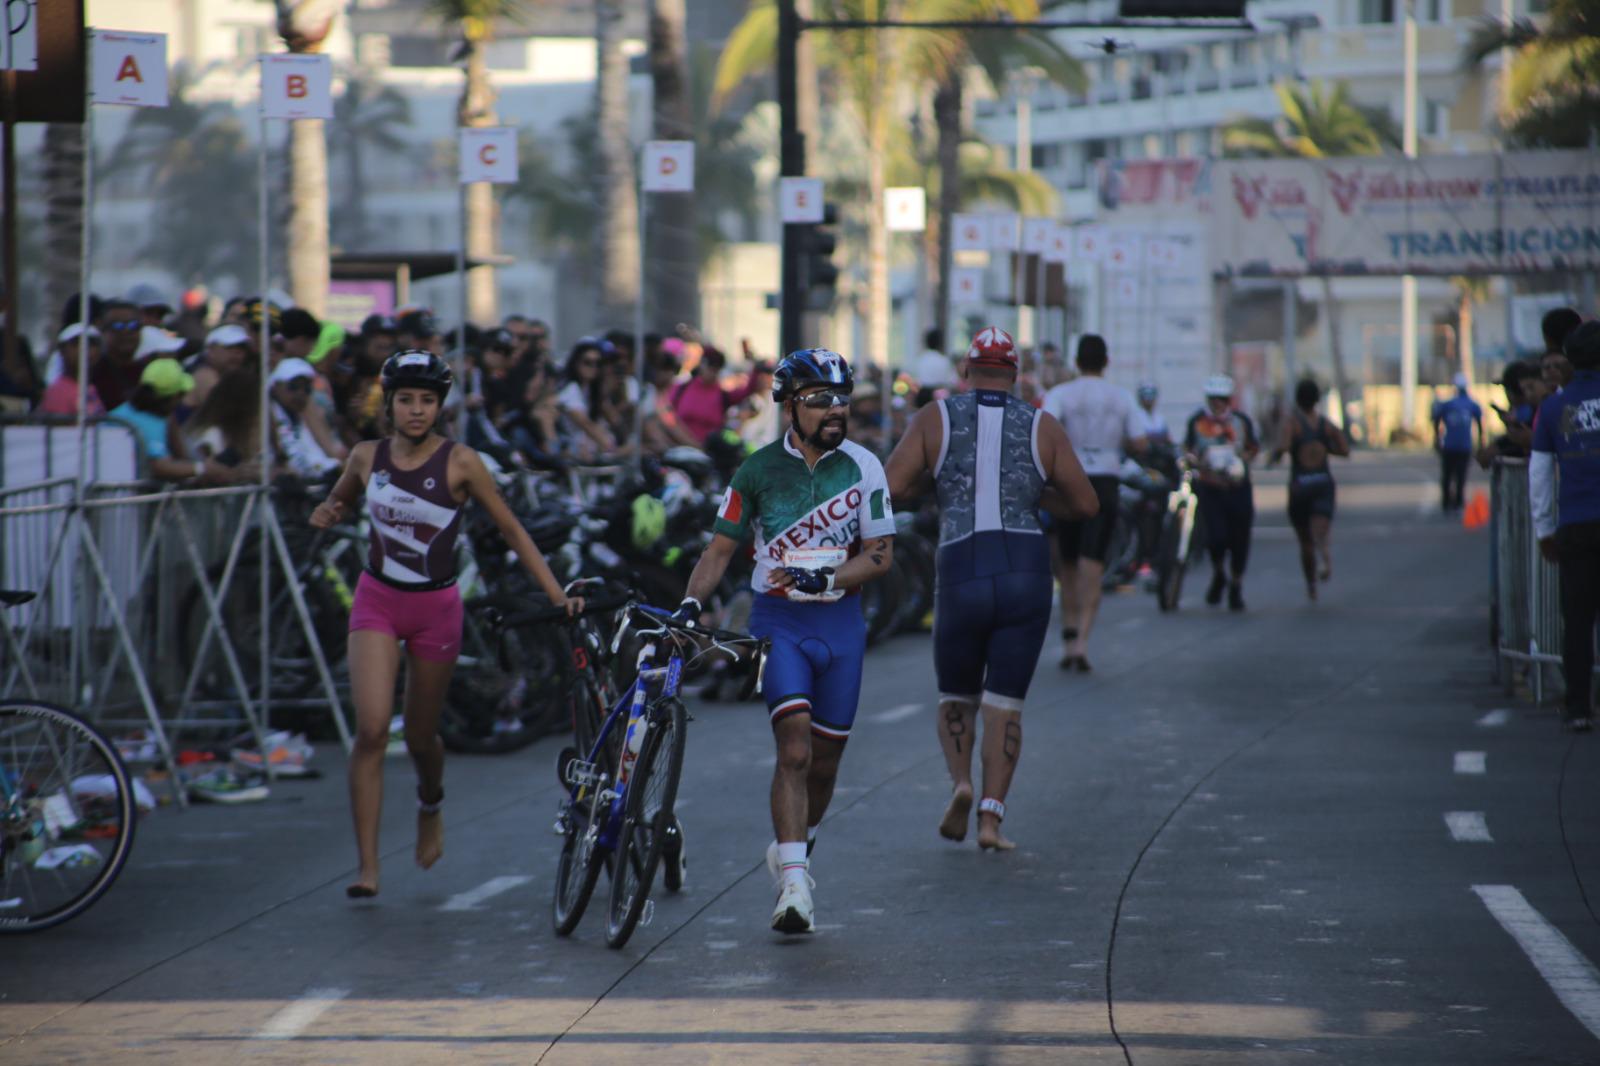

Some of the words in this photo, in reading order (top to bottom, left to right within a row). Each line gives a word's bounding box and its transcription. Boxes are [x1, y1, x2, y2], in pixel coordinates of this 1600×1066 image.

[115, 54, 144, 83] A
[286, 74, 308, 98] B
[479, 144, 498, 166] C
[658, 157, 678, 175] D
[1387, 221, 1600, 259] TRANSICIÓN
[768, 488, 862, 562] MEXICO
